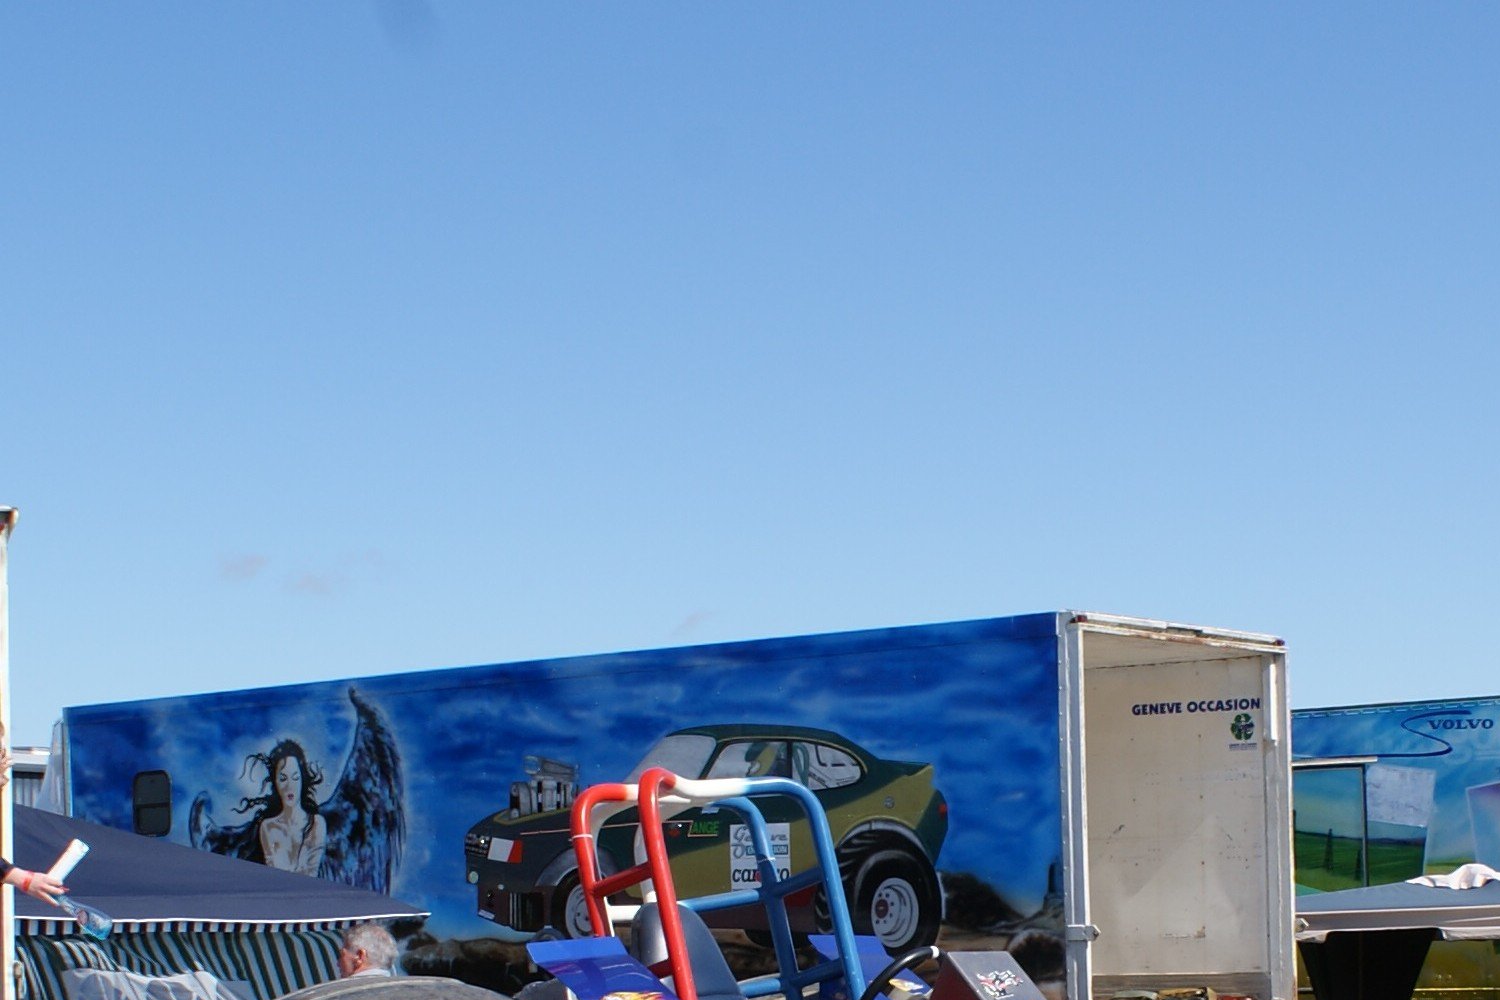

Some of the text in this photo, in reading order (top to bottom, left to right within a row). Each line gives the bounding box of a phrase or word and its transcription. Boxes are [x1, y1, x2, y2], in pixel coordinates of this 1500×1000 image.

[1132, 698, 1261, 715] GENEVE OCCASION
[1428, 718, 1494, 730] VOLVO
[692, 820, 719, 834] ANGE
